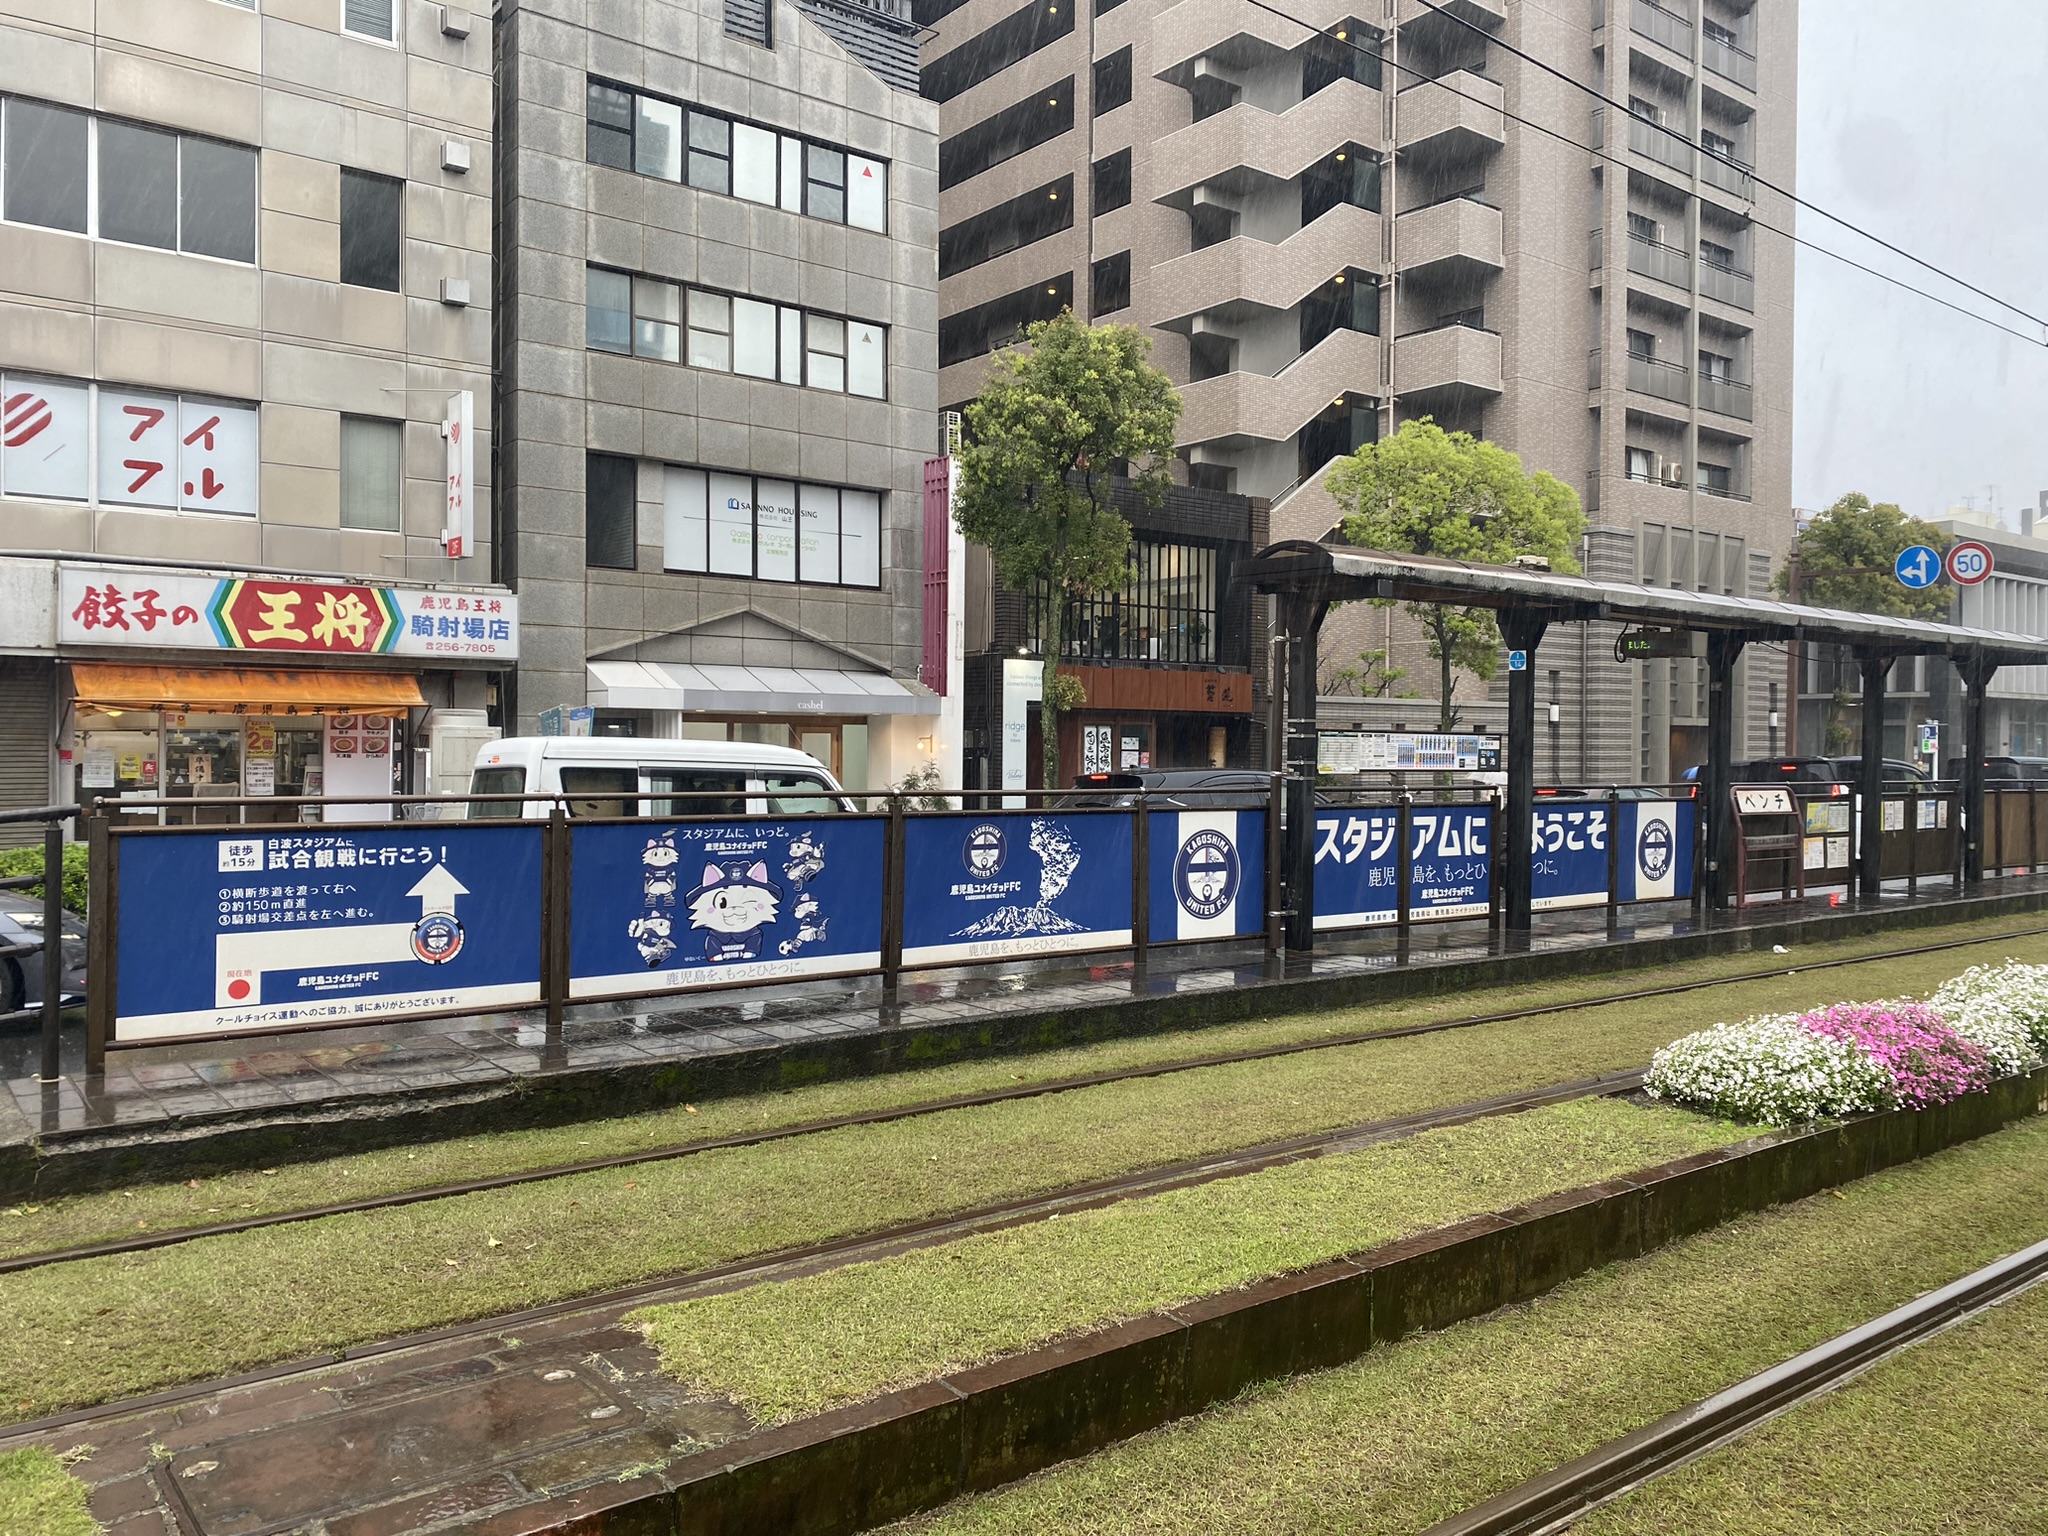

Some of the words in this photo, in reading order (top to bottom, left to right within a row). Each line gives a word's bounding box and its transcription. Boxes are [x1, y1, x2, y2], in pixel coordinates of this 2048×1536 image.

[778, 507, 818, 519] HOUSING
[451, 540, 459, 554] 2F
[1957, 554, 1983, 573] 50
[420, 595, 502, 614] 鹿児島王将
[72, 584, 199, 632] 餃子の
[247, 589, 371, 648] 王将
[411, 615, 510, 641] 騎射場店
[435, 642, 496, 653] 256-7805
[797, 699, 824, 710] cashel
[1005, 722, 1026, 733] ridge
[1745, 792, 1785, 810] ベンチ
[970, 825, 1001, 839] KAGOSHIMA
[228, 845, 254, 857] 徒歩
[1186, 834, 1230, 855] KAGOSHIMA
[969, 865, 990, 877] UNITED
[991, 864, 999, 874] FC
[949, 881, 1021, 896] 鹿児島ユナイテッドFC
[1186, 896, 1216, 915] UNITED
[1216, 894, 1228, 910] FC
[968, 937, 1080, 958] 鹿児島を、もっとひとつに。
[226, 970, 253, 978] 現在地
[665, 961, 807, 986] 鹿児島を、もっとひとつに。
